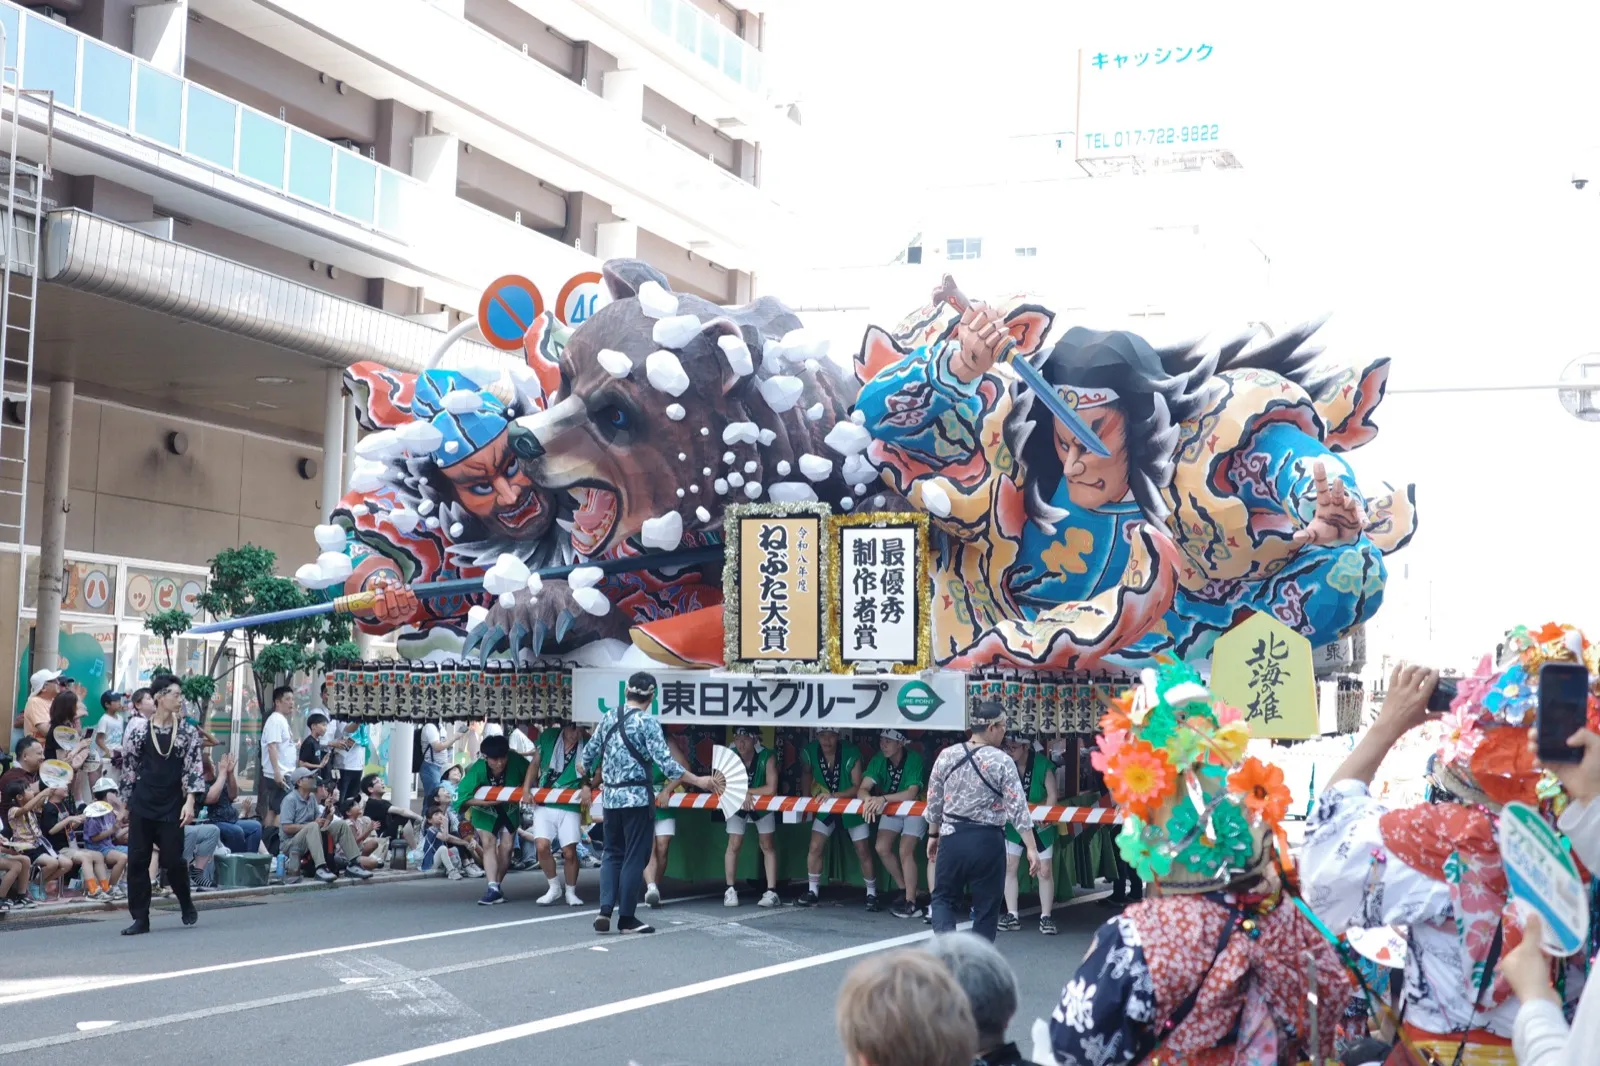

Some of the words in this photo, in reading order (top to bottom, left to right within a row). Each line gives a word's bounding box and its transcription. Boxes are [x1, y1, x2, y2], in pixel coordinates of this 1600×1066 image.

[1085, 132, 1110, 149] TEL
[759, 524, 789, 652] ねぶた大賞
[796, 526, 809, 593] 令和八年度
[852, 537, 878, 651] 制作者賞
[880, 537, 906, 625] 最優秀
[1245, 631, 1291, 725] 北海の雄
